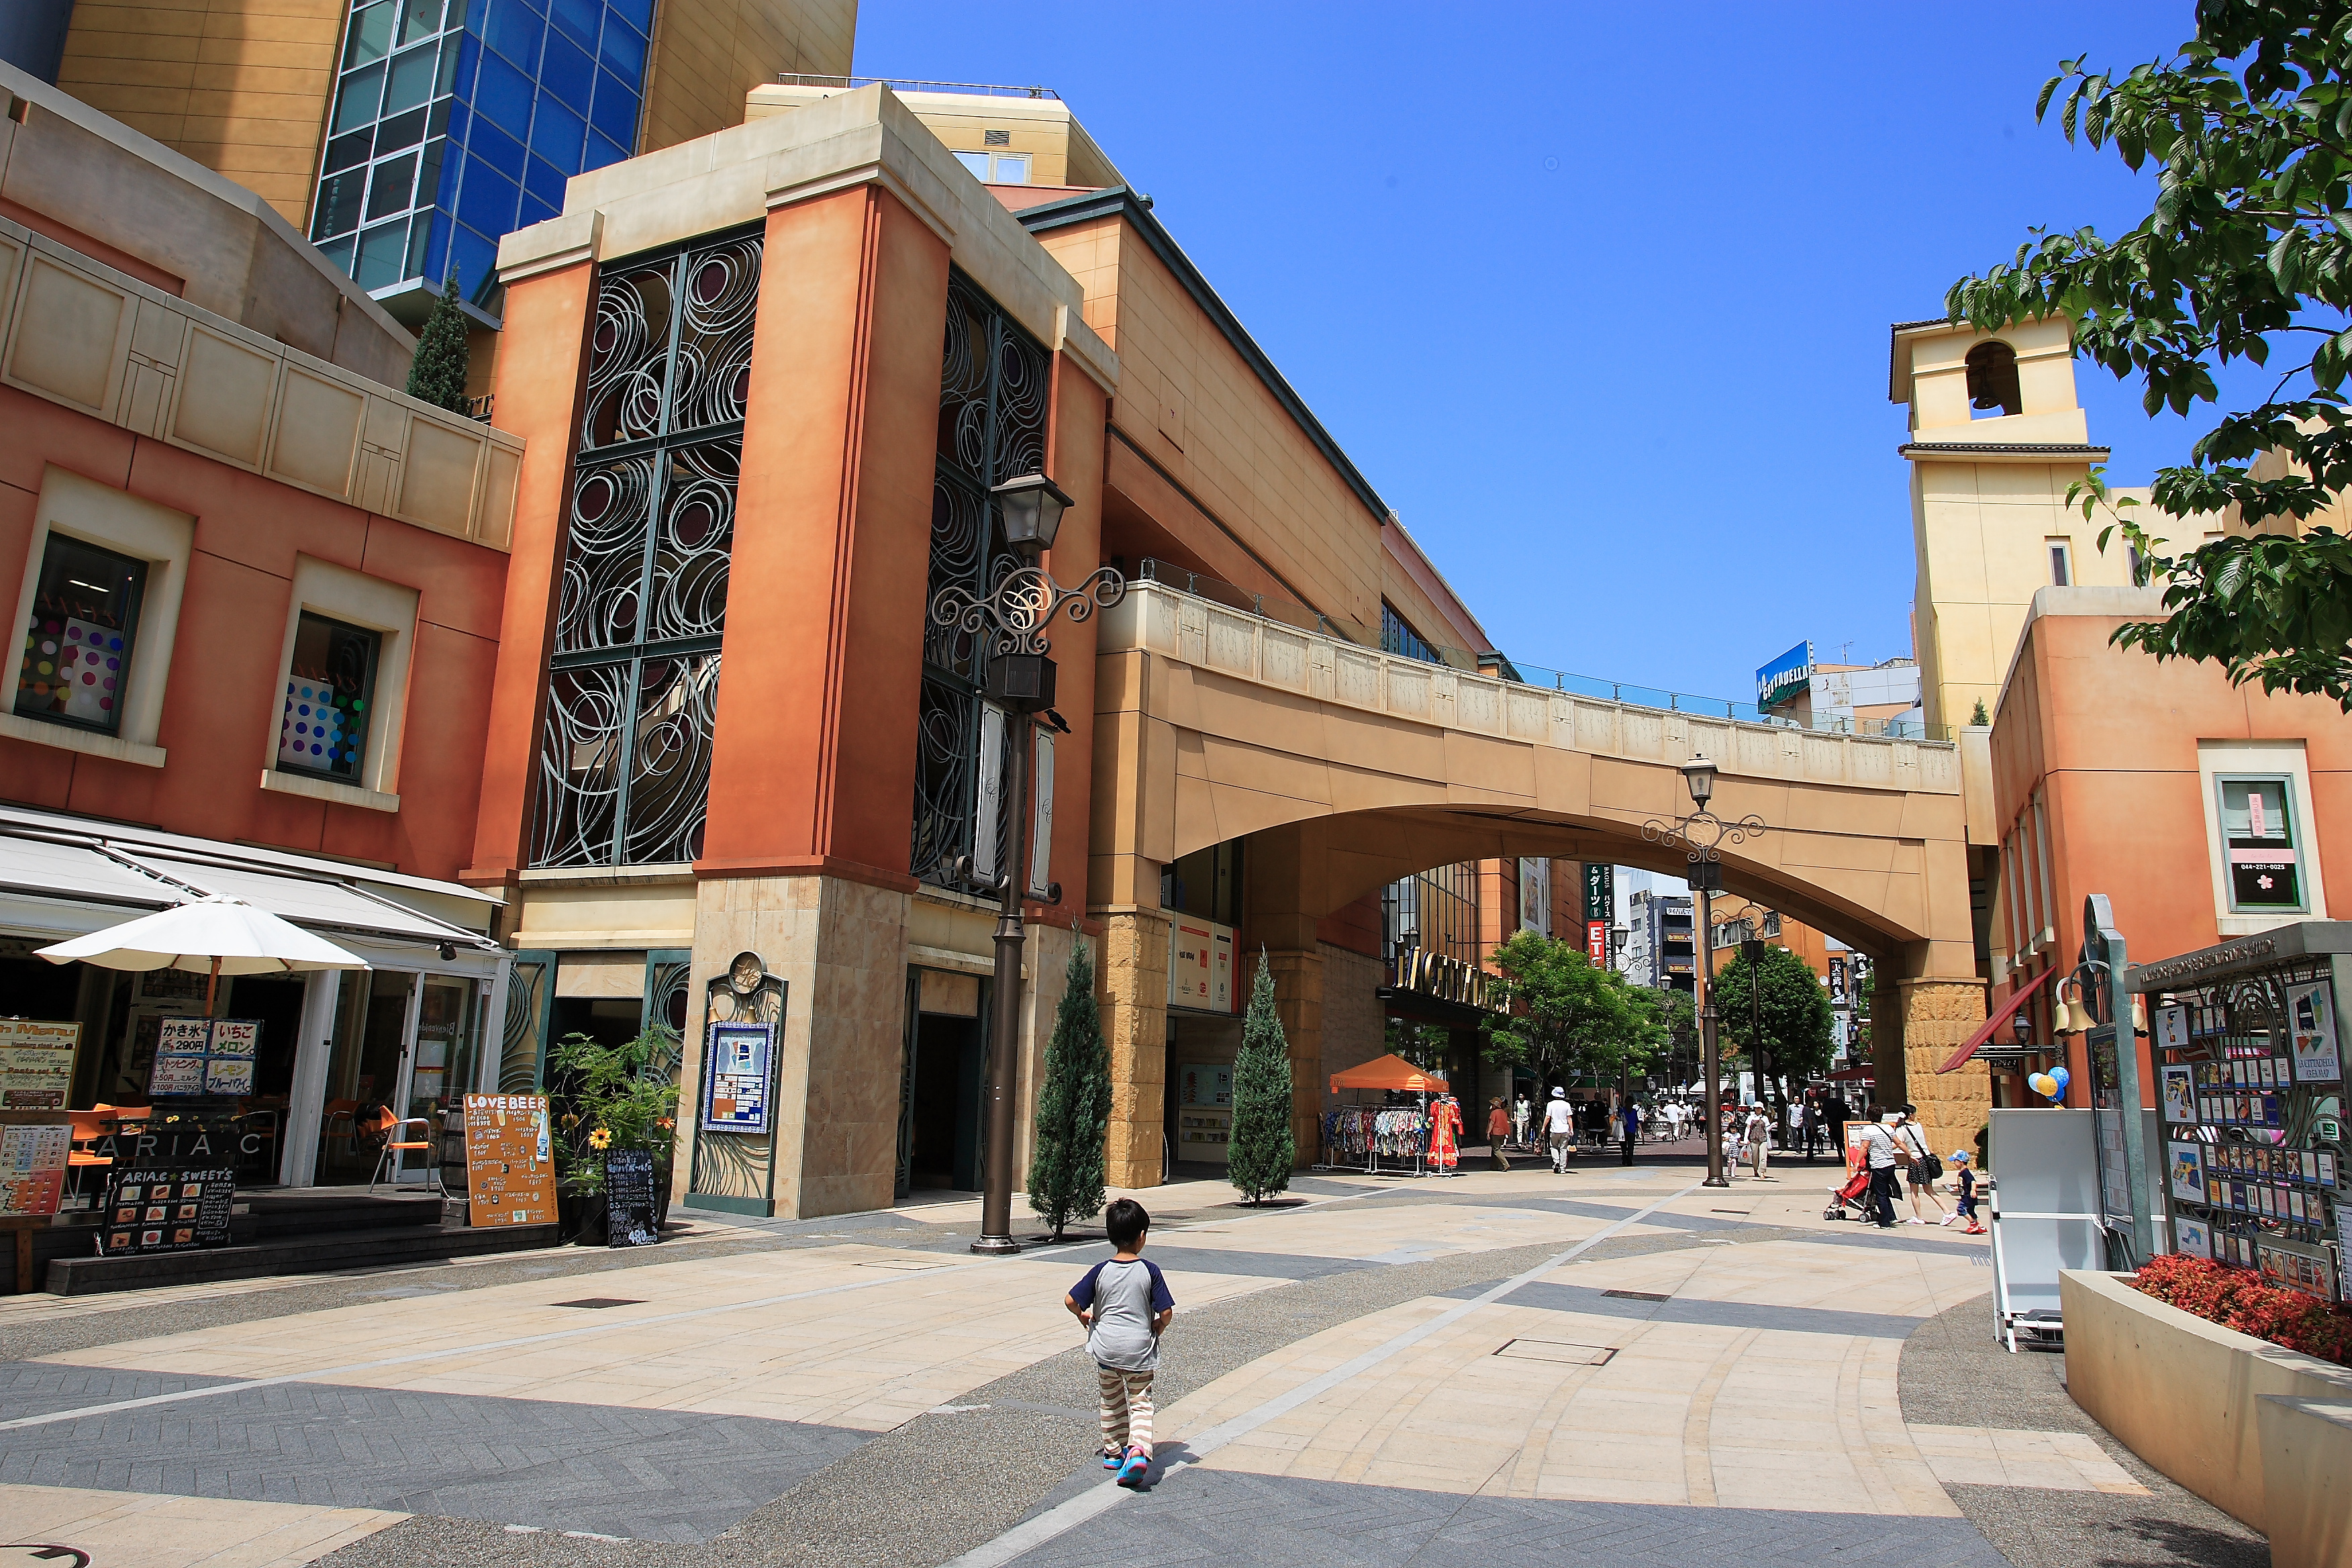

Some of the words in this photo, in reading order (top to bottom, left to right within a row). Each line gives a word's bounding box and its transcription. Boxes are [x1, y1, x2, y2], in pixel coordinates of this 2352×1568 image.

[1763, 665, 1808, 700] CITTADELLA
[16, 1024, 76, 1036] Menu
[163, 1024, 200, 1038] かき氷
[176, 1040, 205, 1051] 290円
[216, 1040, 250, 1052] メロン
[164, 1059, 198, 1069] トッピング
[214, 1065, 247, 1076] レモン
[208, 1077, 248, 1088] ブルーハワイ
[467, 1095, 507, 1110] LOVE
[508, 1096, 546, 1110] BEER
[96, 1133, 261, 1157] ARIA.C
[181, 1167, 234, 1182] SWEET'S
